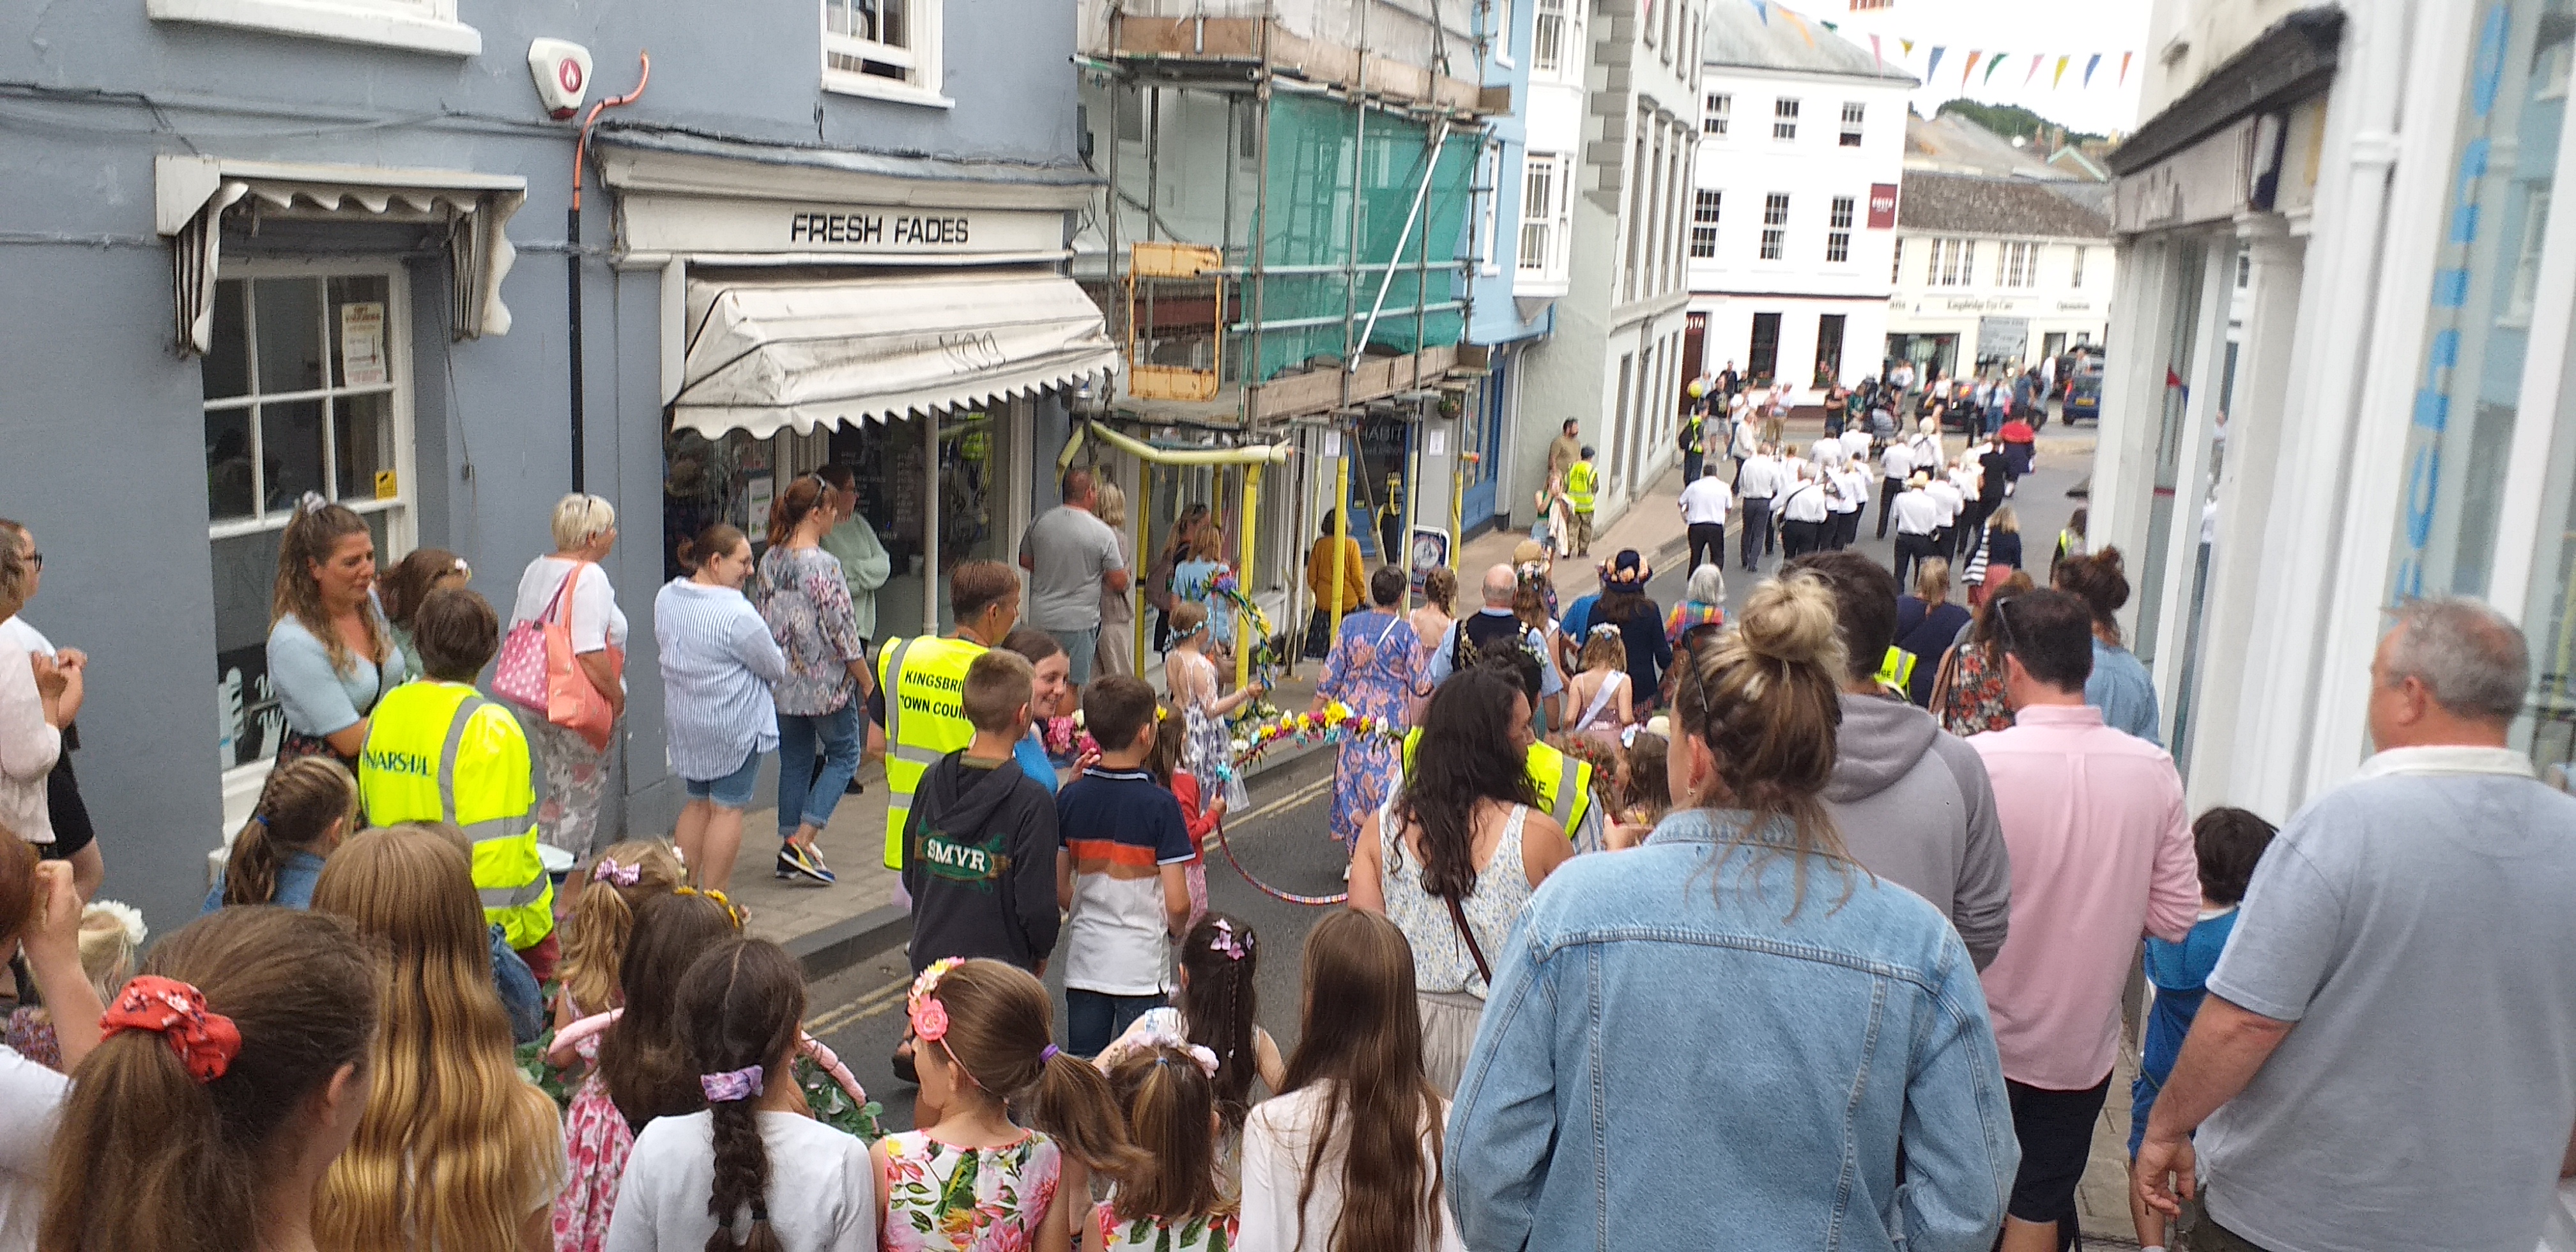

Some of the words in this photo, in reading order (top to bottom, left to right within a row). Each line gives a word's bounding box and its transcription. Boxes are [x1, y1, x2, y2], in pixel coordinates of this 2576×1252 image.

[791, 212, 883, 244] FRESH
[894, 215, 969, 245] FADES
[905, 669, 962, 693] KINGSBRI
[900, 694, 930, 714] TOWN
[933, 701, 967, 719] COUN
[927, 838, 985, 872] SMVR
